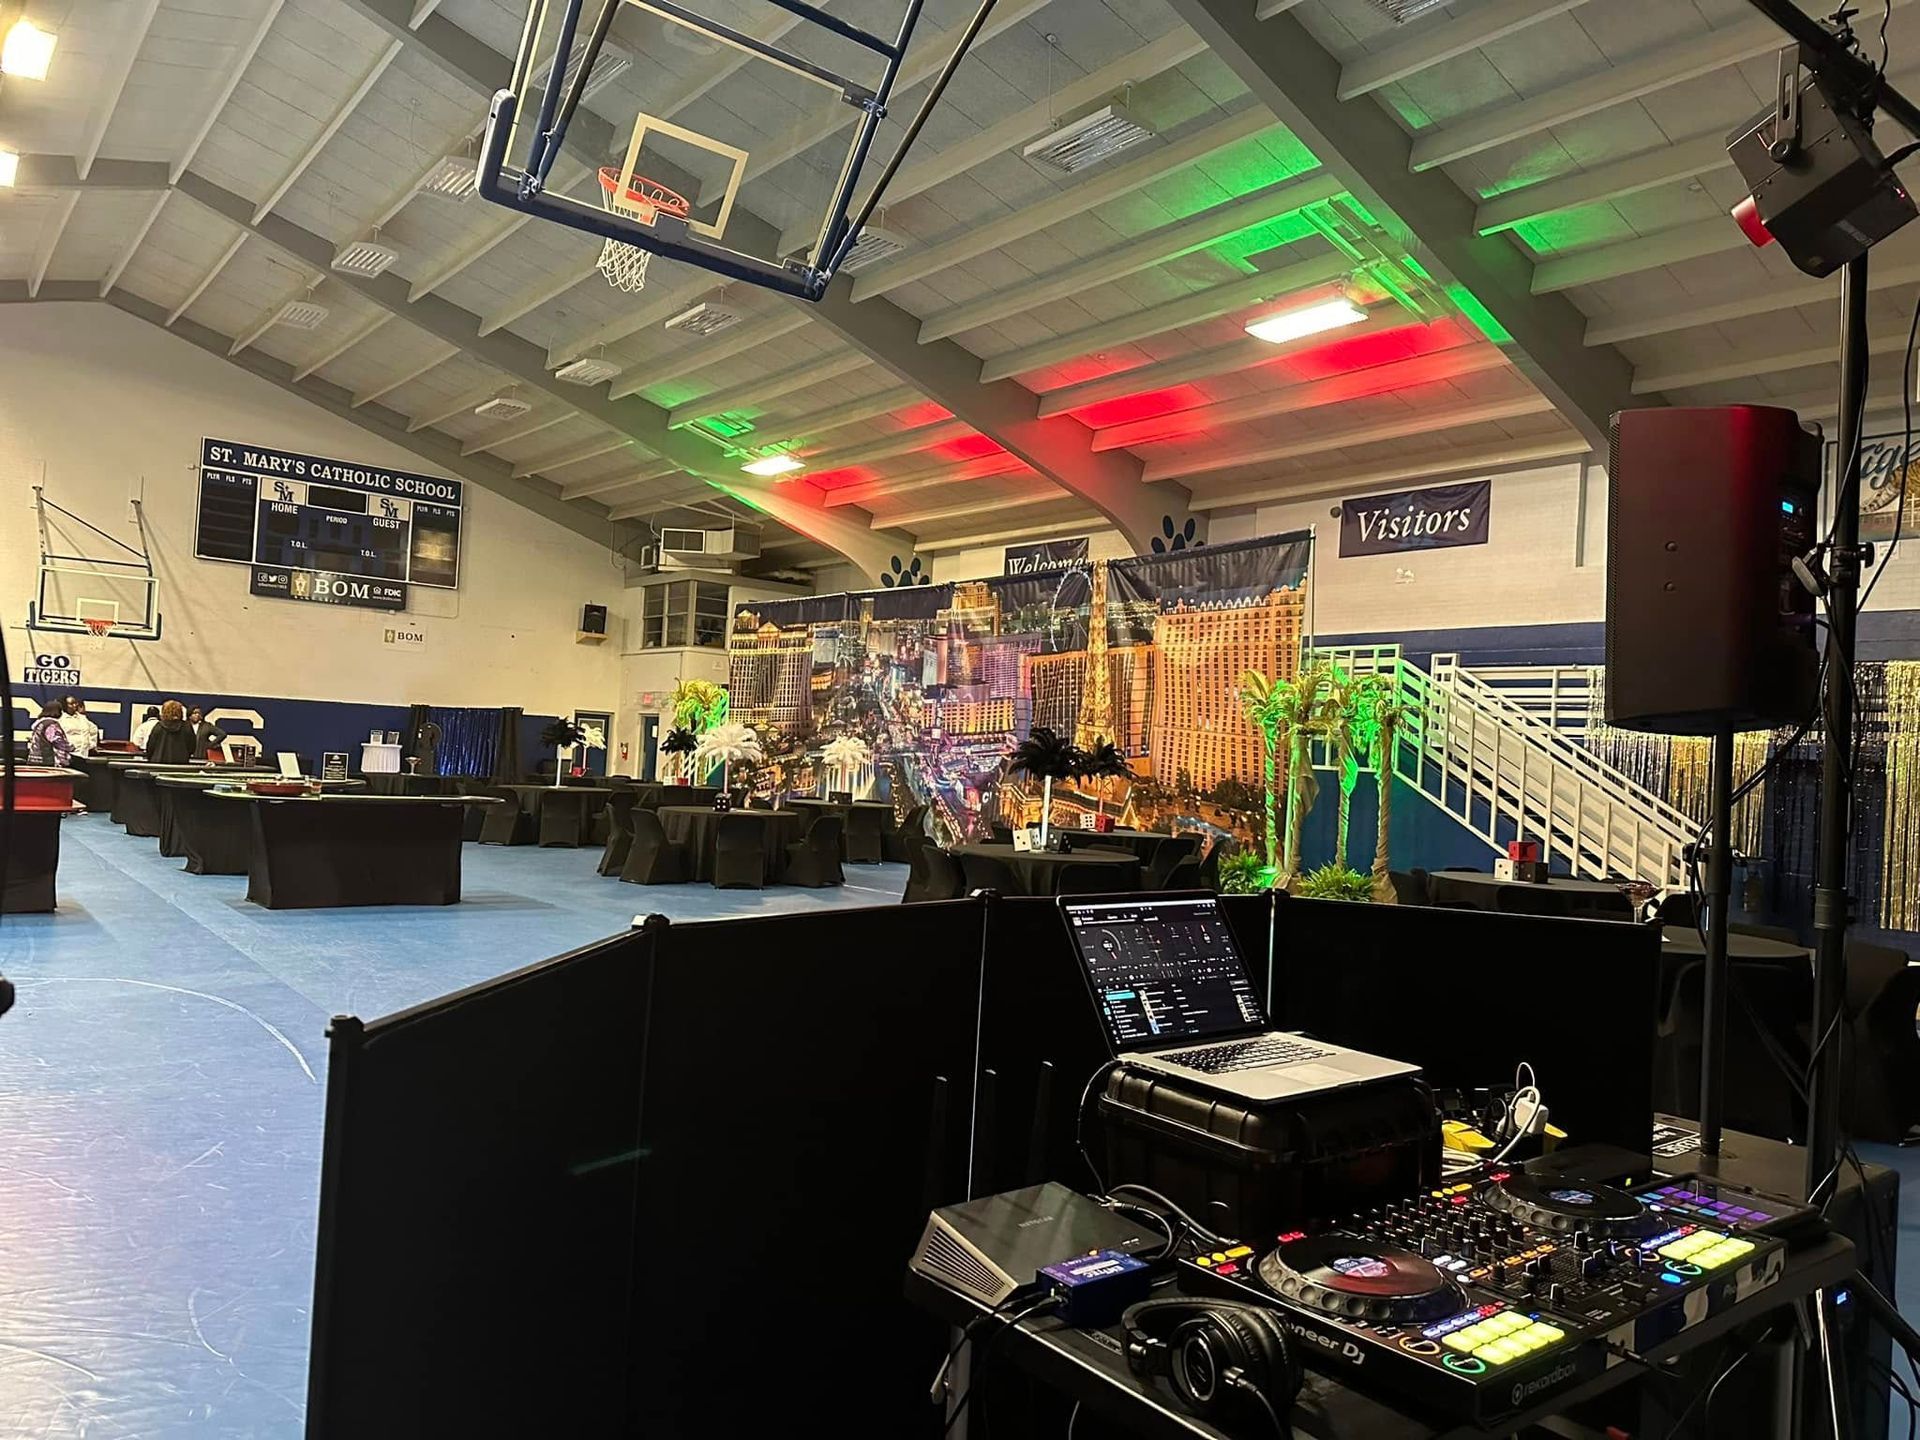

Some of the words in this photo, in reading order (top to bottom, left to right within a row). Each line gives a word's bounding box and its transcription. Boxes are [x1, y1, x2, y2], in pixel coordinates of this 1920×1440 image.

[210, 446, 237, 464] ST.
[243, 451, 306, 475] MARY'S
[310, 463, 391, 489] CATHOLIC
[395, 478, 456, 500] SCHOOL
[242, 477, 252, 486] PTS
[271, 502, 299, 515] HOME
[325, 515, 348, 525] PERIOD
[372, 518, 401, 529] GUEST
[1357, 505, 1471, 542] Visitors
[313, 578, 371, 600] BOM
[383, 588, 402, 597] FDIC
[397, 632, 424, 643] BOM
[35, 654, 71, 669] GO
[25, 668, 79, 686] TIGERS
